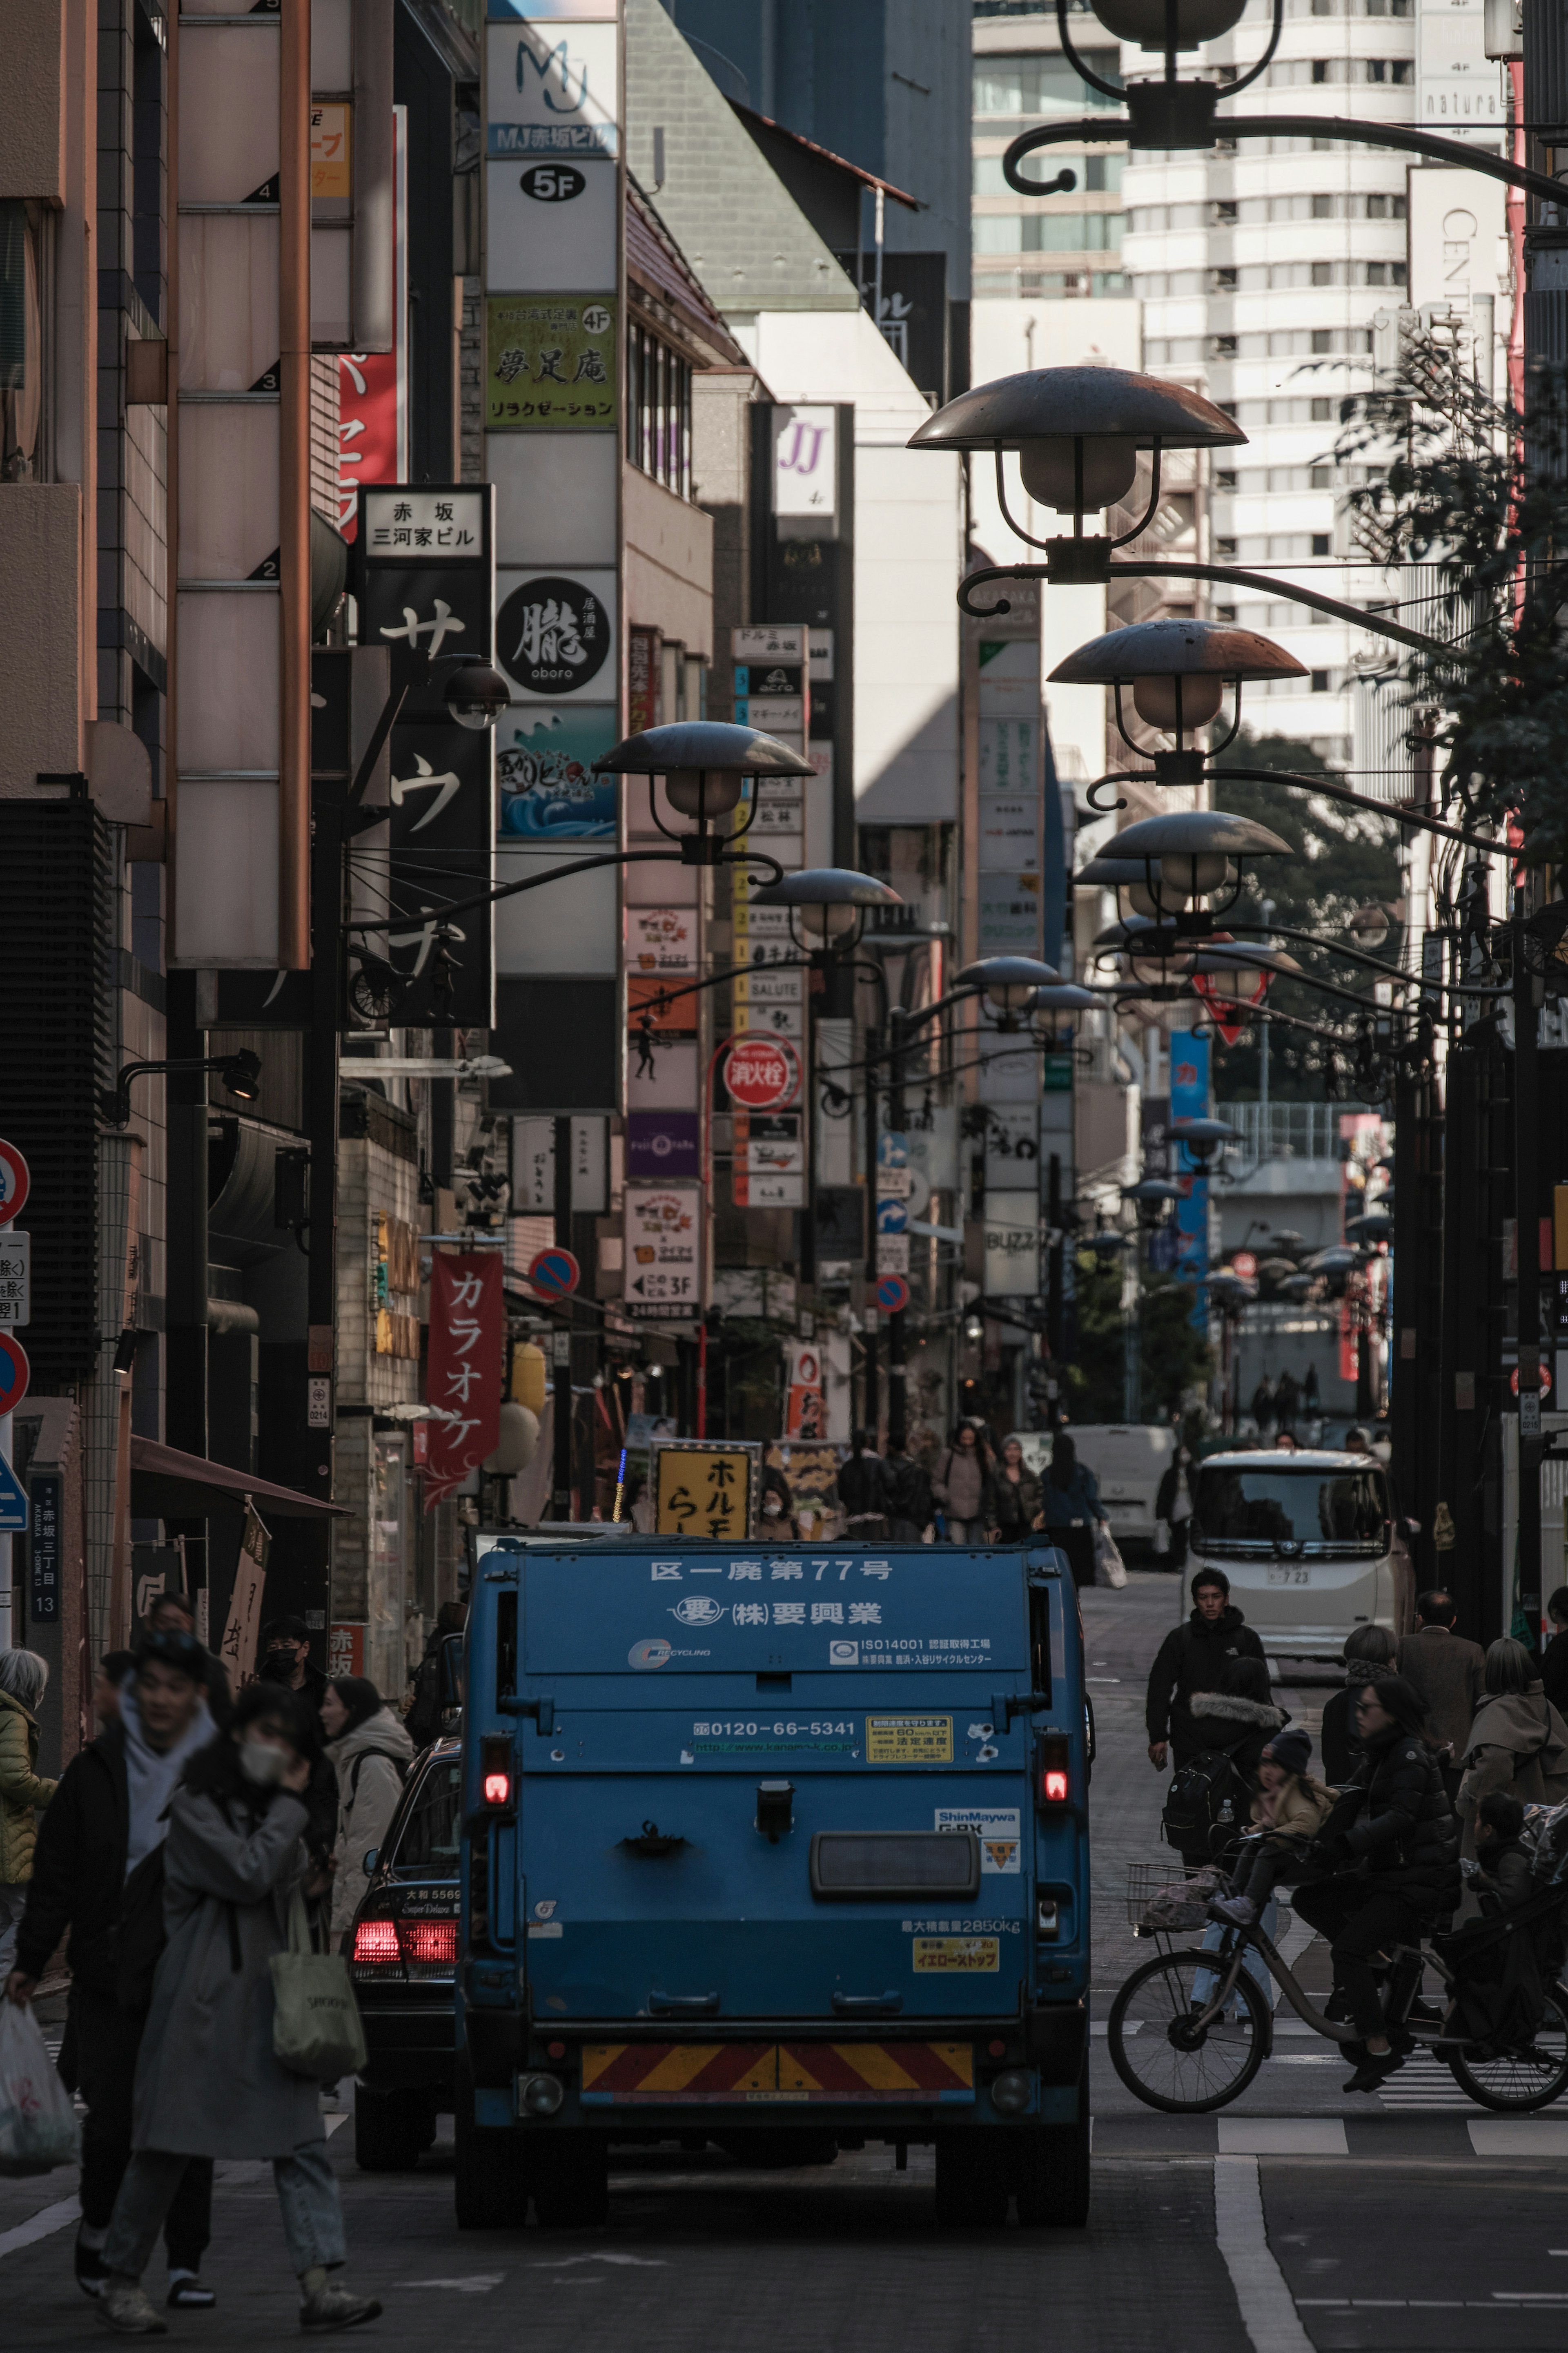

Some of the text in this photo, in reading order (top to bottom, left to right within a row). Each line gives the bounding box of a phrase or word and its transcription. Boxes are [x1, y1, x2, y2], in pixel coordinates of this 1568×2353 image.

[1428, 92, 1494, 114] natura
[497, 127, 608, 149] MJ赤坂ビル
[259, 185, 270, 198] 4
[533, 170, 574, 198] 5F
[584, 310, 608, 329] 4F
[494, 348, 606, 385] 夢足庵
[263, 375, 276, 388] 3
[492, 401, 612, 417] リラクゼーション
[778, 421, 830, 474] JJ
[373, 527, 475, 546] 三河家ビル
[264, 562, 276, 576] 2
[583, 597, 595, 638] 居酒屋
[532, 667, 572, 678] oboro
[752, 983, 798, 996] SALUTE
[731, 1060, 784, 1087] 消火栓
[671, 1276, 691, 1295] 3F
[441, 1271, 483, 1449] カラオケ
[310, 1411, 327, 1420] 0214
[37, 1597, 54, 1612] 13
[732, 1602, 882, 1626] (株)要興業
[861, 1639, 991, 1650] ISO14001 認証取得工場
[330, 1629, 354, 1677] 赤坂
[712, 1722, 854, 1736] 0120-66-5341
[897, 1737, 947, 1746] 法定速度
[939, 1812, 1016, 1824] ShinMaywa
[406, 1890, 429, 1900] 大和
[402, 1902, 450, 1916] Super Deluxe
[901, 1920, 1020, 1934] 最大積載量2850kg
[918, 1954, 996, 1967] イエローストップ
